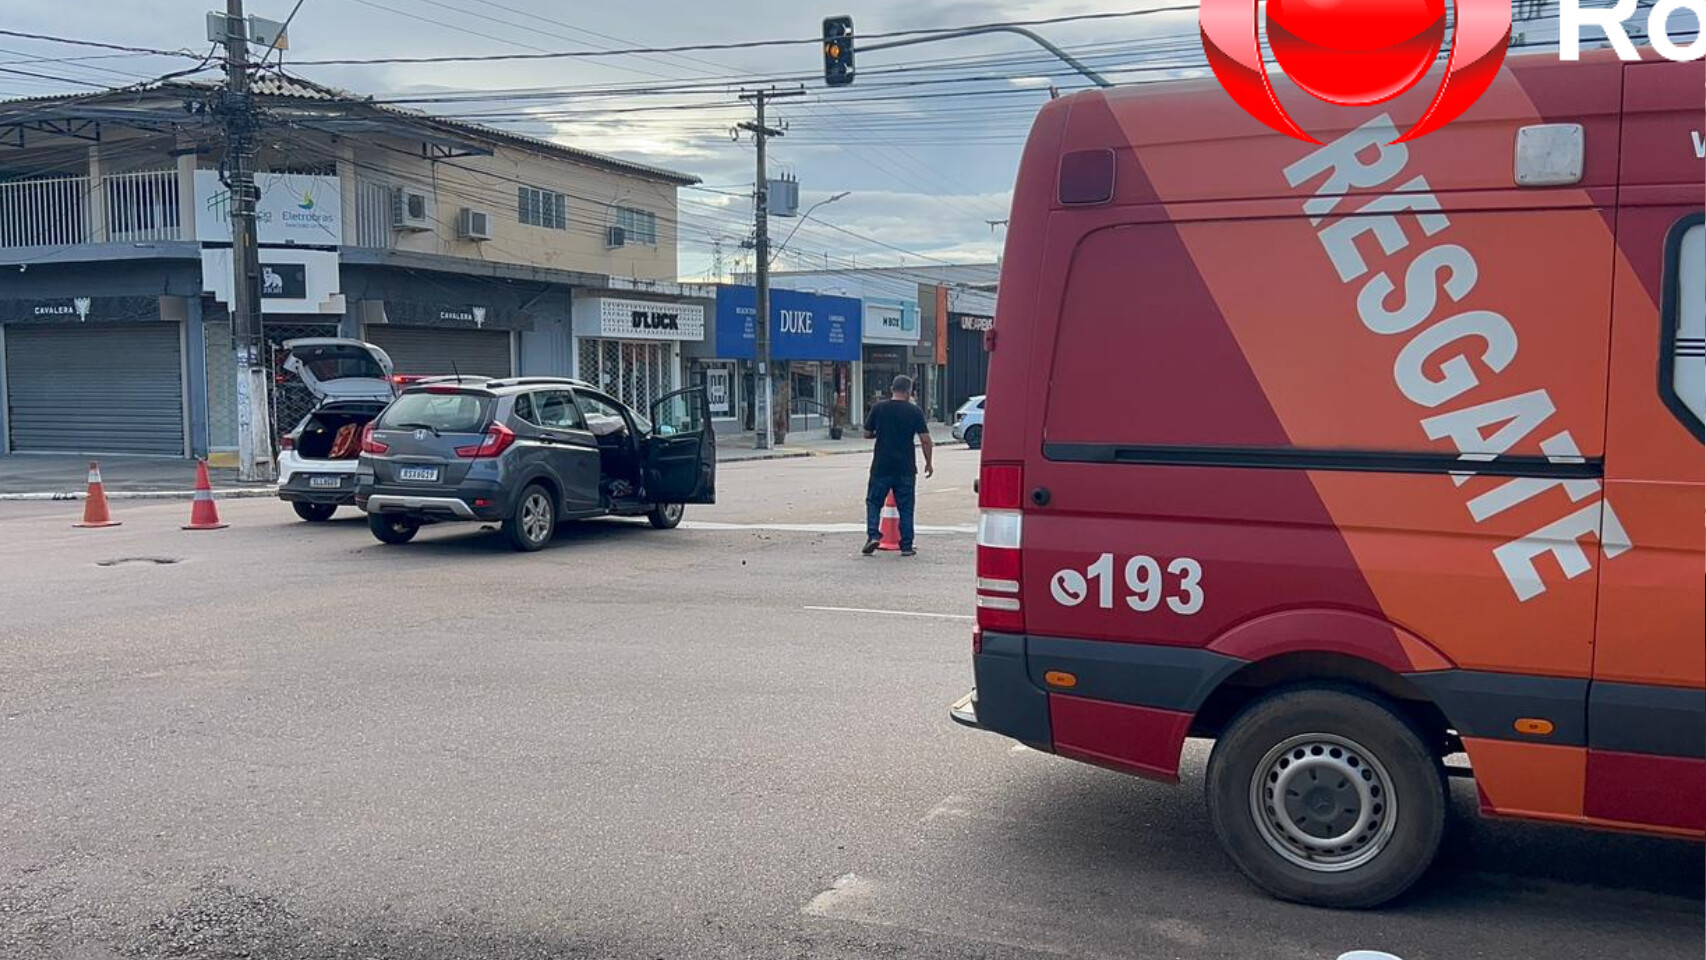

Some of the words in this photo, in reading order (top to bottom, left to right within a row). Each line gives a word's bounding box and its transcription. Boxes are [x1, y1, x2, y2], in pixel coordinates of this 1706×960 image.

[34, 306, 74, 315] CAVALERA
[440, 312, 472, 321] CAVALERA
[780, 309, 813, 334] DUKE
[1282, 112, 1634, 603] RESGATE
[1086, 553, 1205, 615] 193
